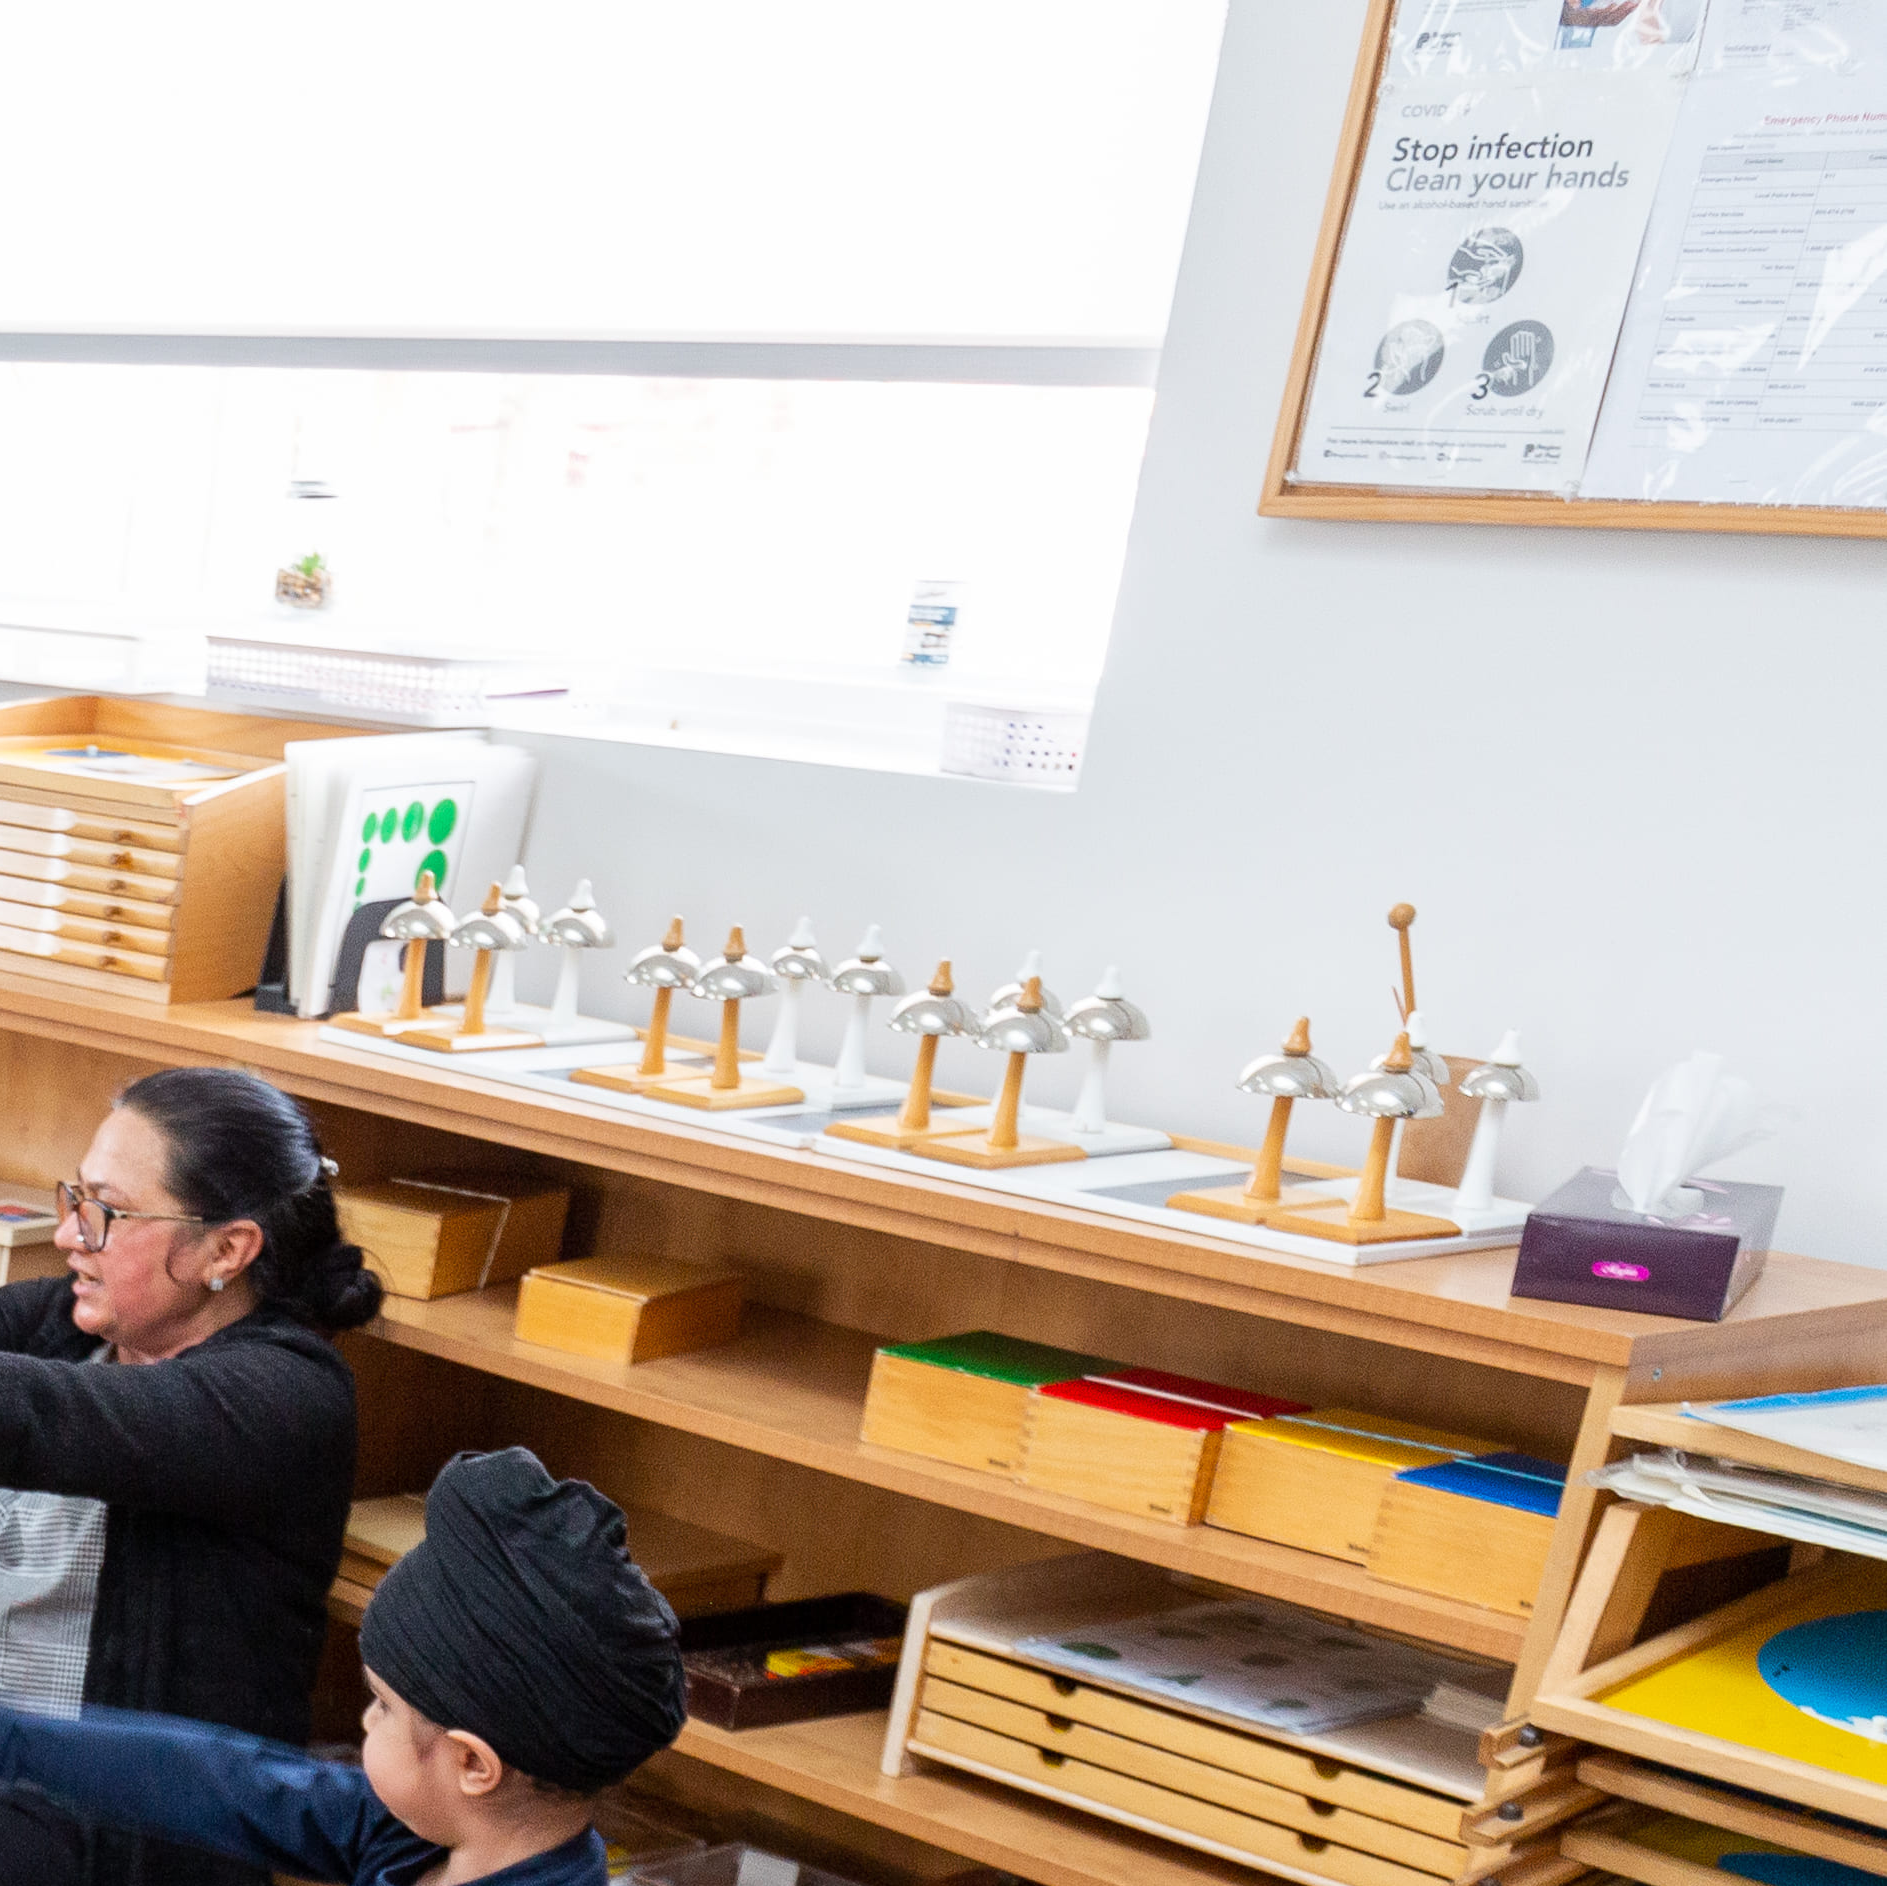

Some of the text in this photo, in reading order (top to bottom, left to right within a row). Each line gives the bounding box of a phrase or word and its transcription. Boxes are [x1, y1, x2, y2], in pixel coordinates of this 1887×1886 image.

[1392, 132, 1594, 168] Stop infection
[1386, 161, 1629, 198] Clean your hands
[1363, 371, 1382, 398] 2
[1471, 372, 1491, 400] 3
